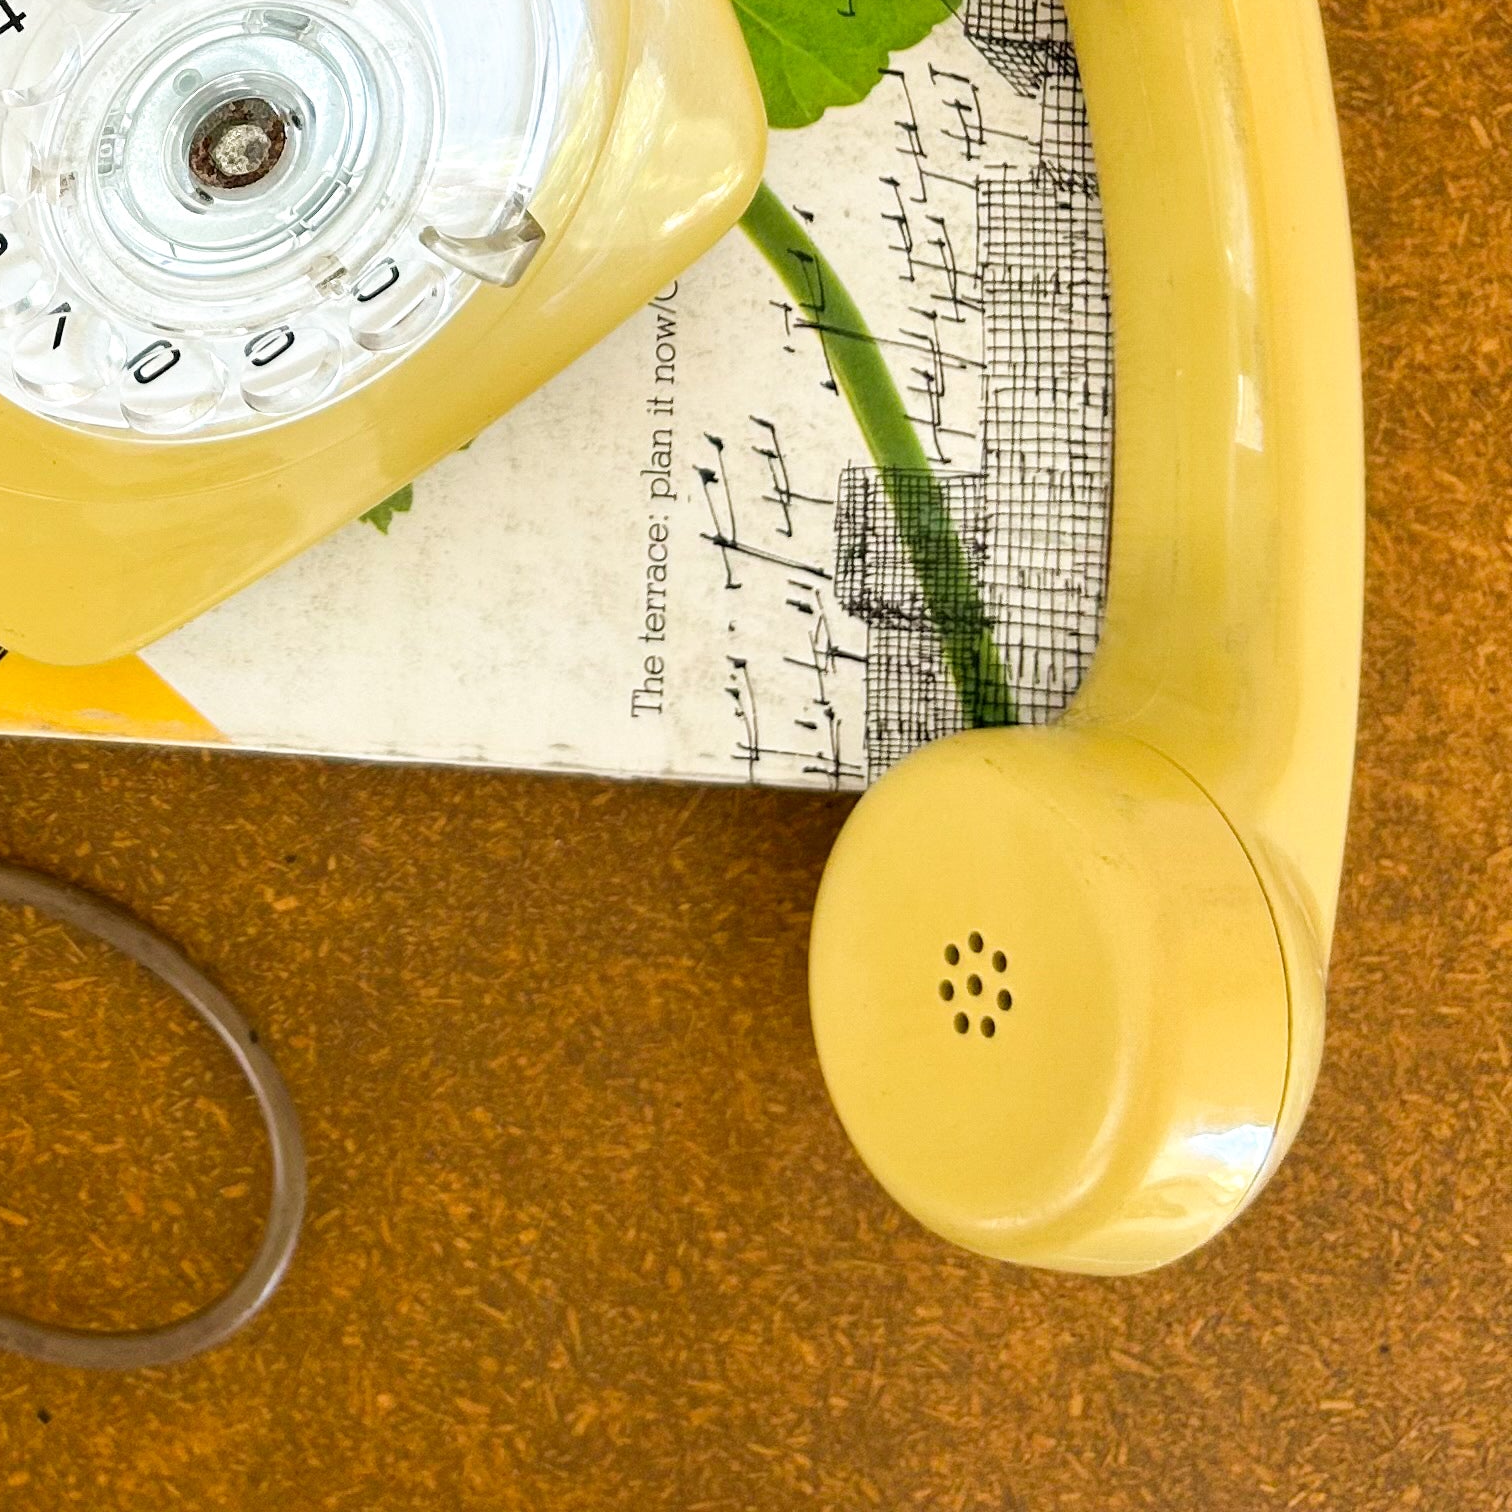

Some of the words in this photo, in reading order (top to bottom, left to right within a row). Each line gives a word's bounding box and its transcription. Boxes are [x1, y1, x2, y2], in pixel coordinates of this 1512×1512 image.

[646, 396, 675, 416] it
[640, 428, 678, 502] plan
[638, 513, 670, 643] terrace:
[630, 654, 664, 719] The
